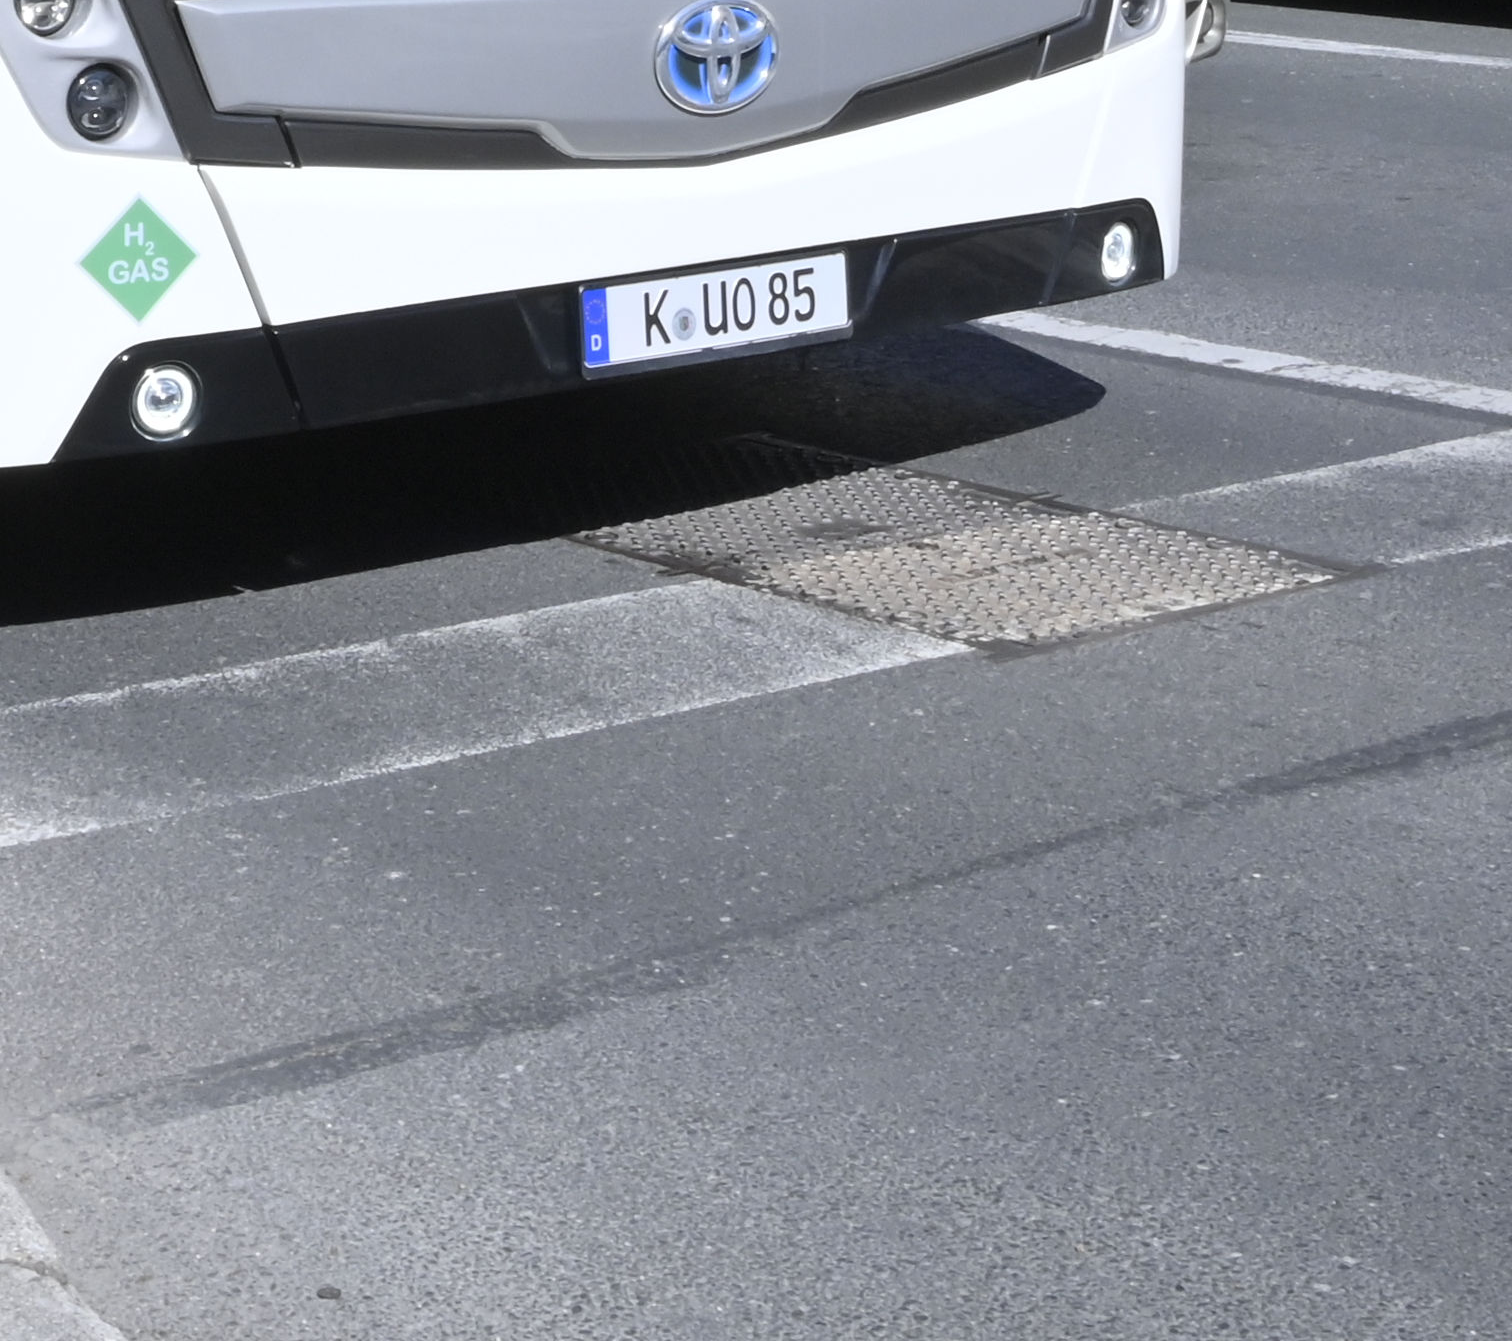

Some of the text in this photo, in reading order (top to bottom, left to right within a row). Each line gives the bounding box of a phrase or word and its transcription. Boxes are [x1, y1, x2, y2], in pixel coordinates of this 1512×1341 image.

[107, 256, 169, 286] GAS
[644, 267, 816, 348] K UO 85
[589, 332, 603, 353] D
